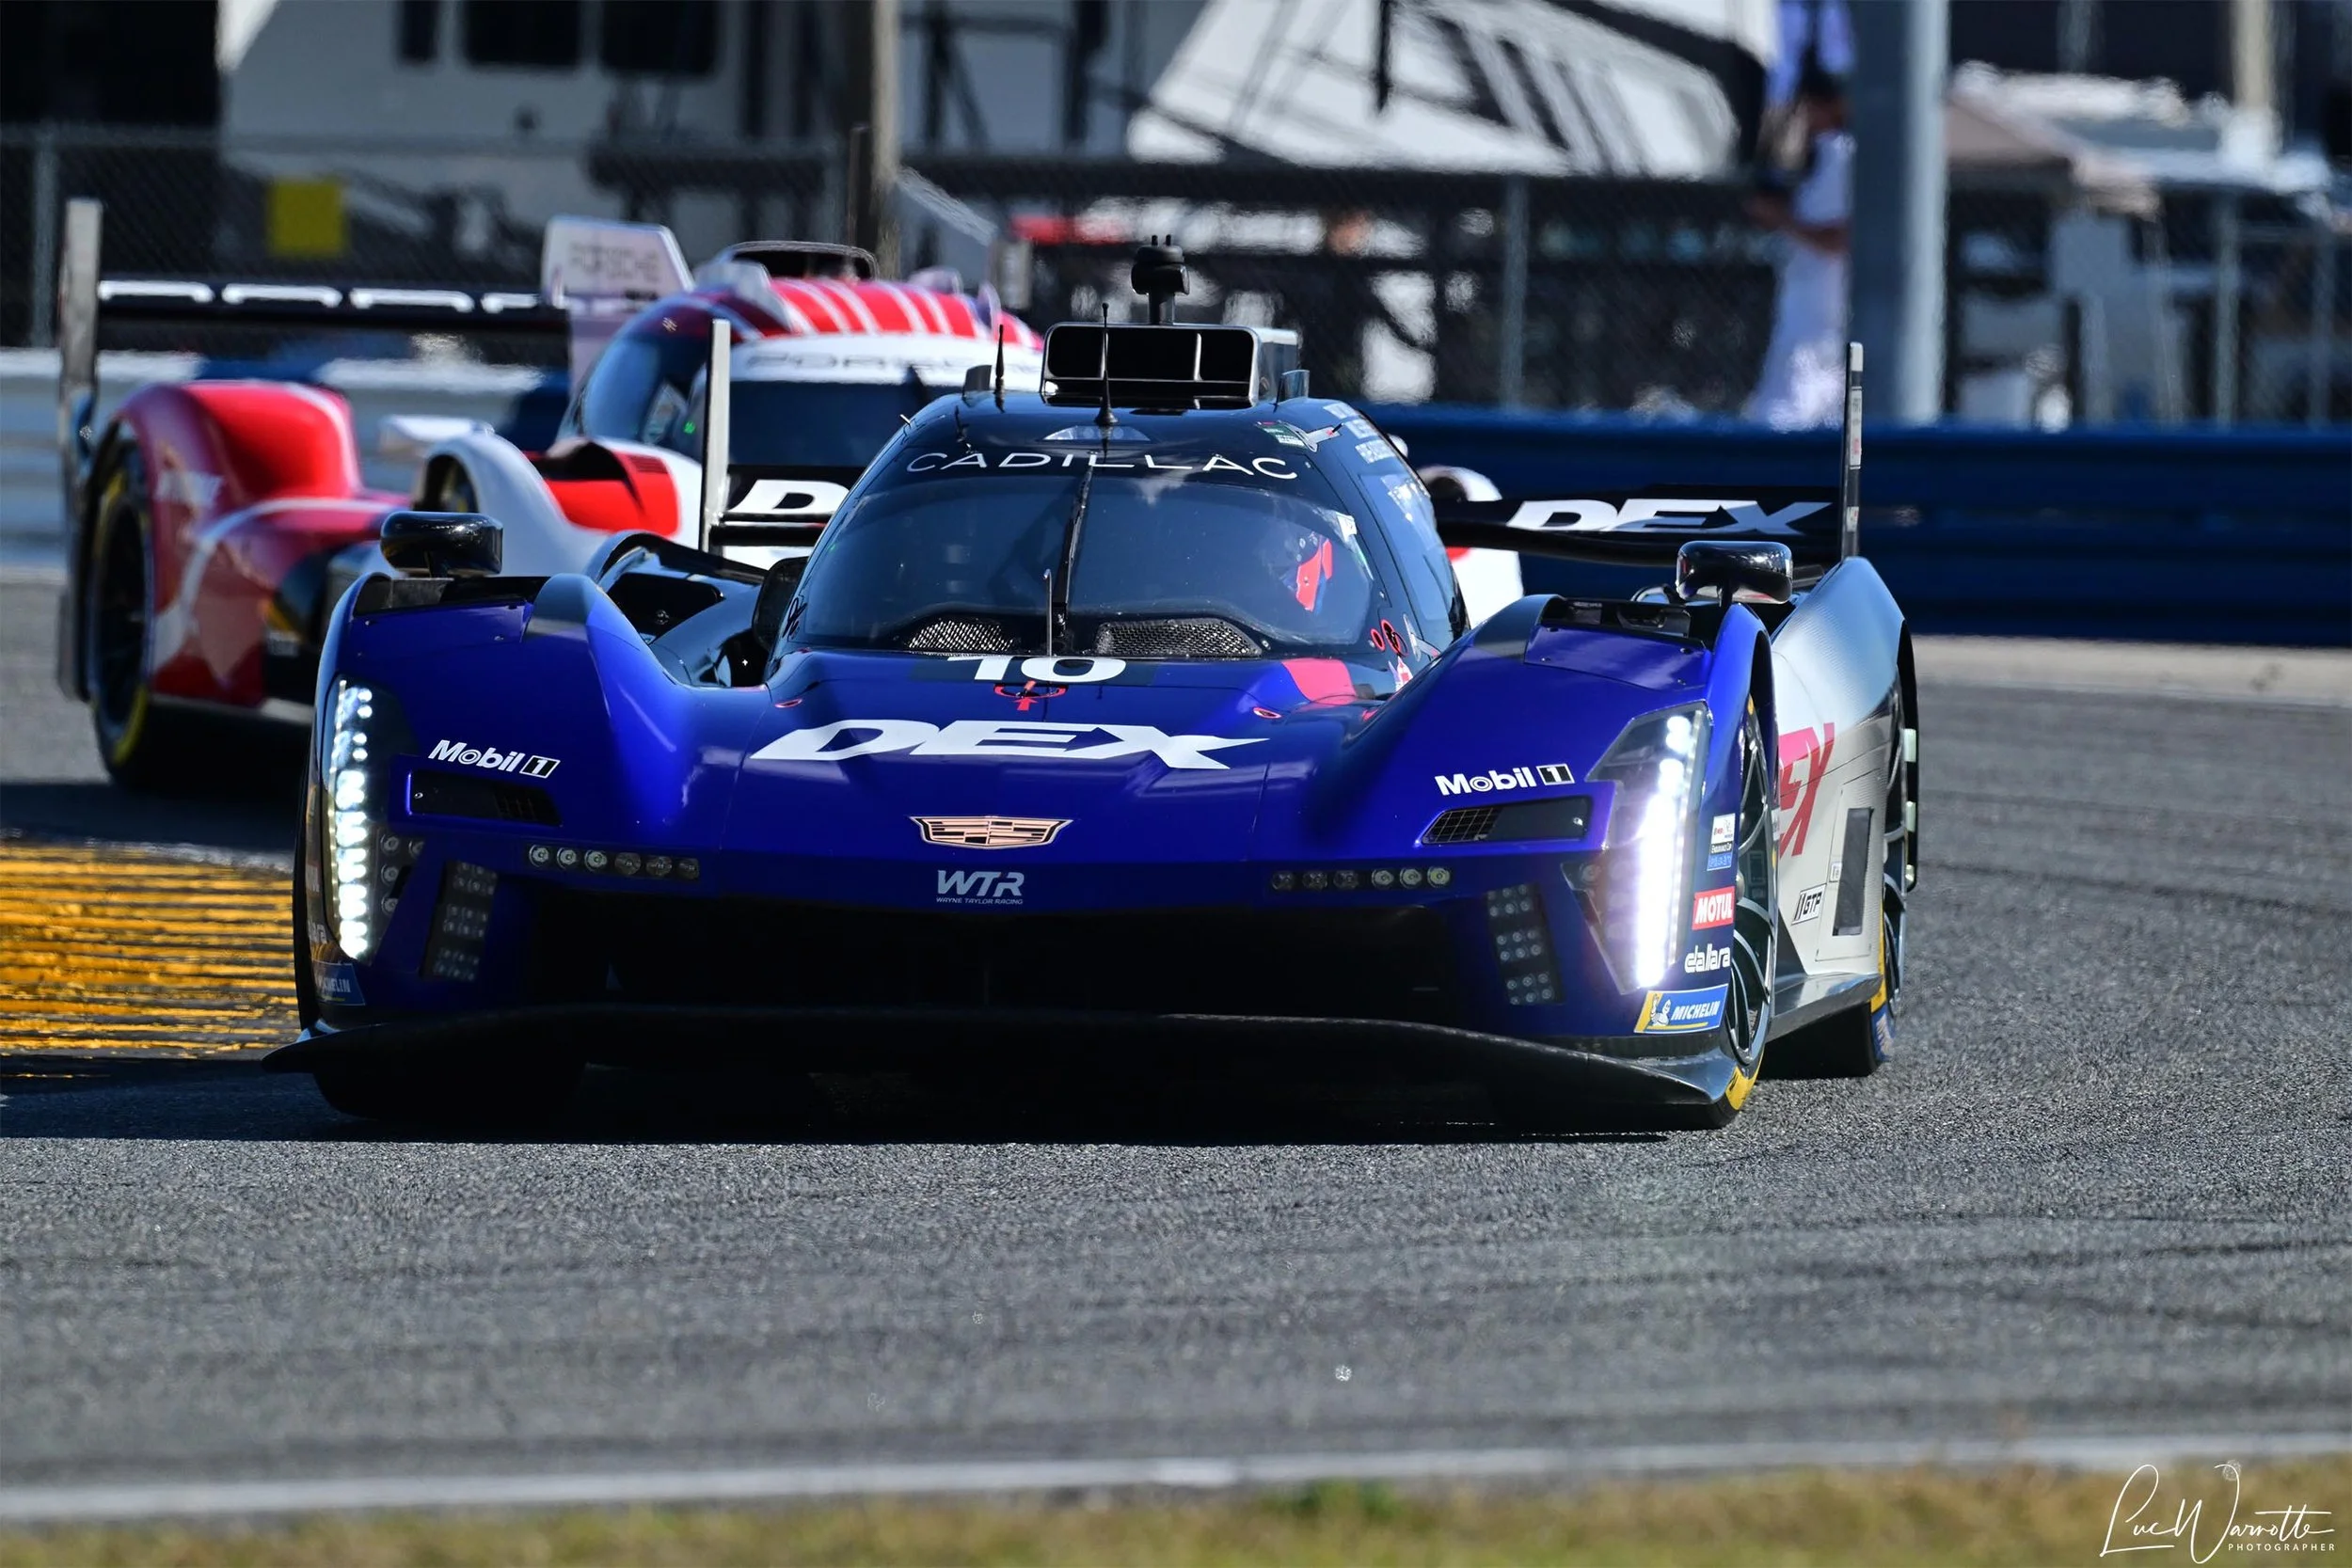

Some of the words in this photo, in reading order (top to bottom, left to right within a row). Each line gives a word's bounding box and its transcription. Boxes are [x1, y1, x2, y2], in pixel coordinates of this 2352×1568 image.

[906, 451, 1298, 481] CADILLAC
[1505, 498, 1834, 536] DEX
[946, 656, 1127, 682] 10
[427, 738, 526, 773] Mobil
[749, 719, 1270, 769] DEX
[1434, 767, 1537, 796] Mobil
[1778, 722, 1835, 859] EX
[937, 869, 1025, 897] WTR
[1694, 893, 1733, 925] MOTUL
[1684, 943, 1731, 974] dallara
[1671, 1000, 1721, 1021] MICHELIN
